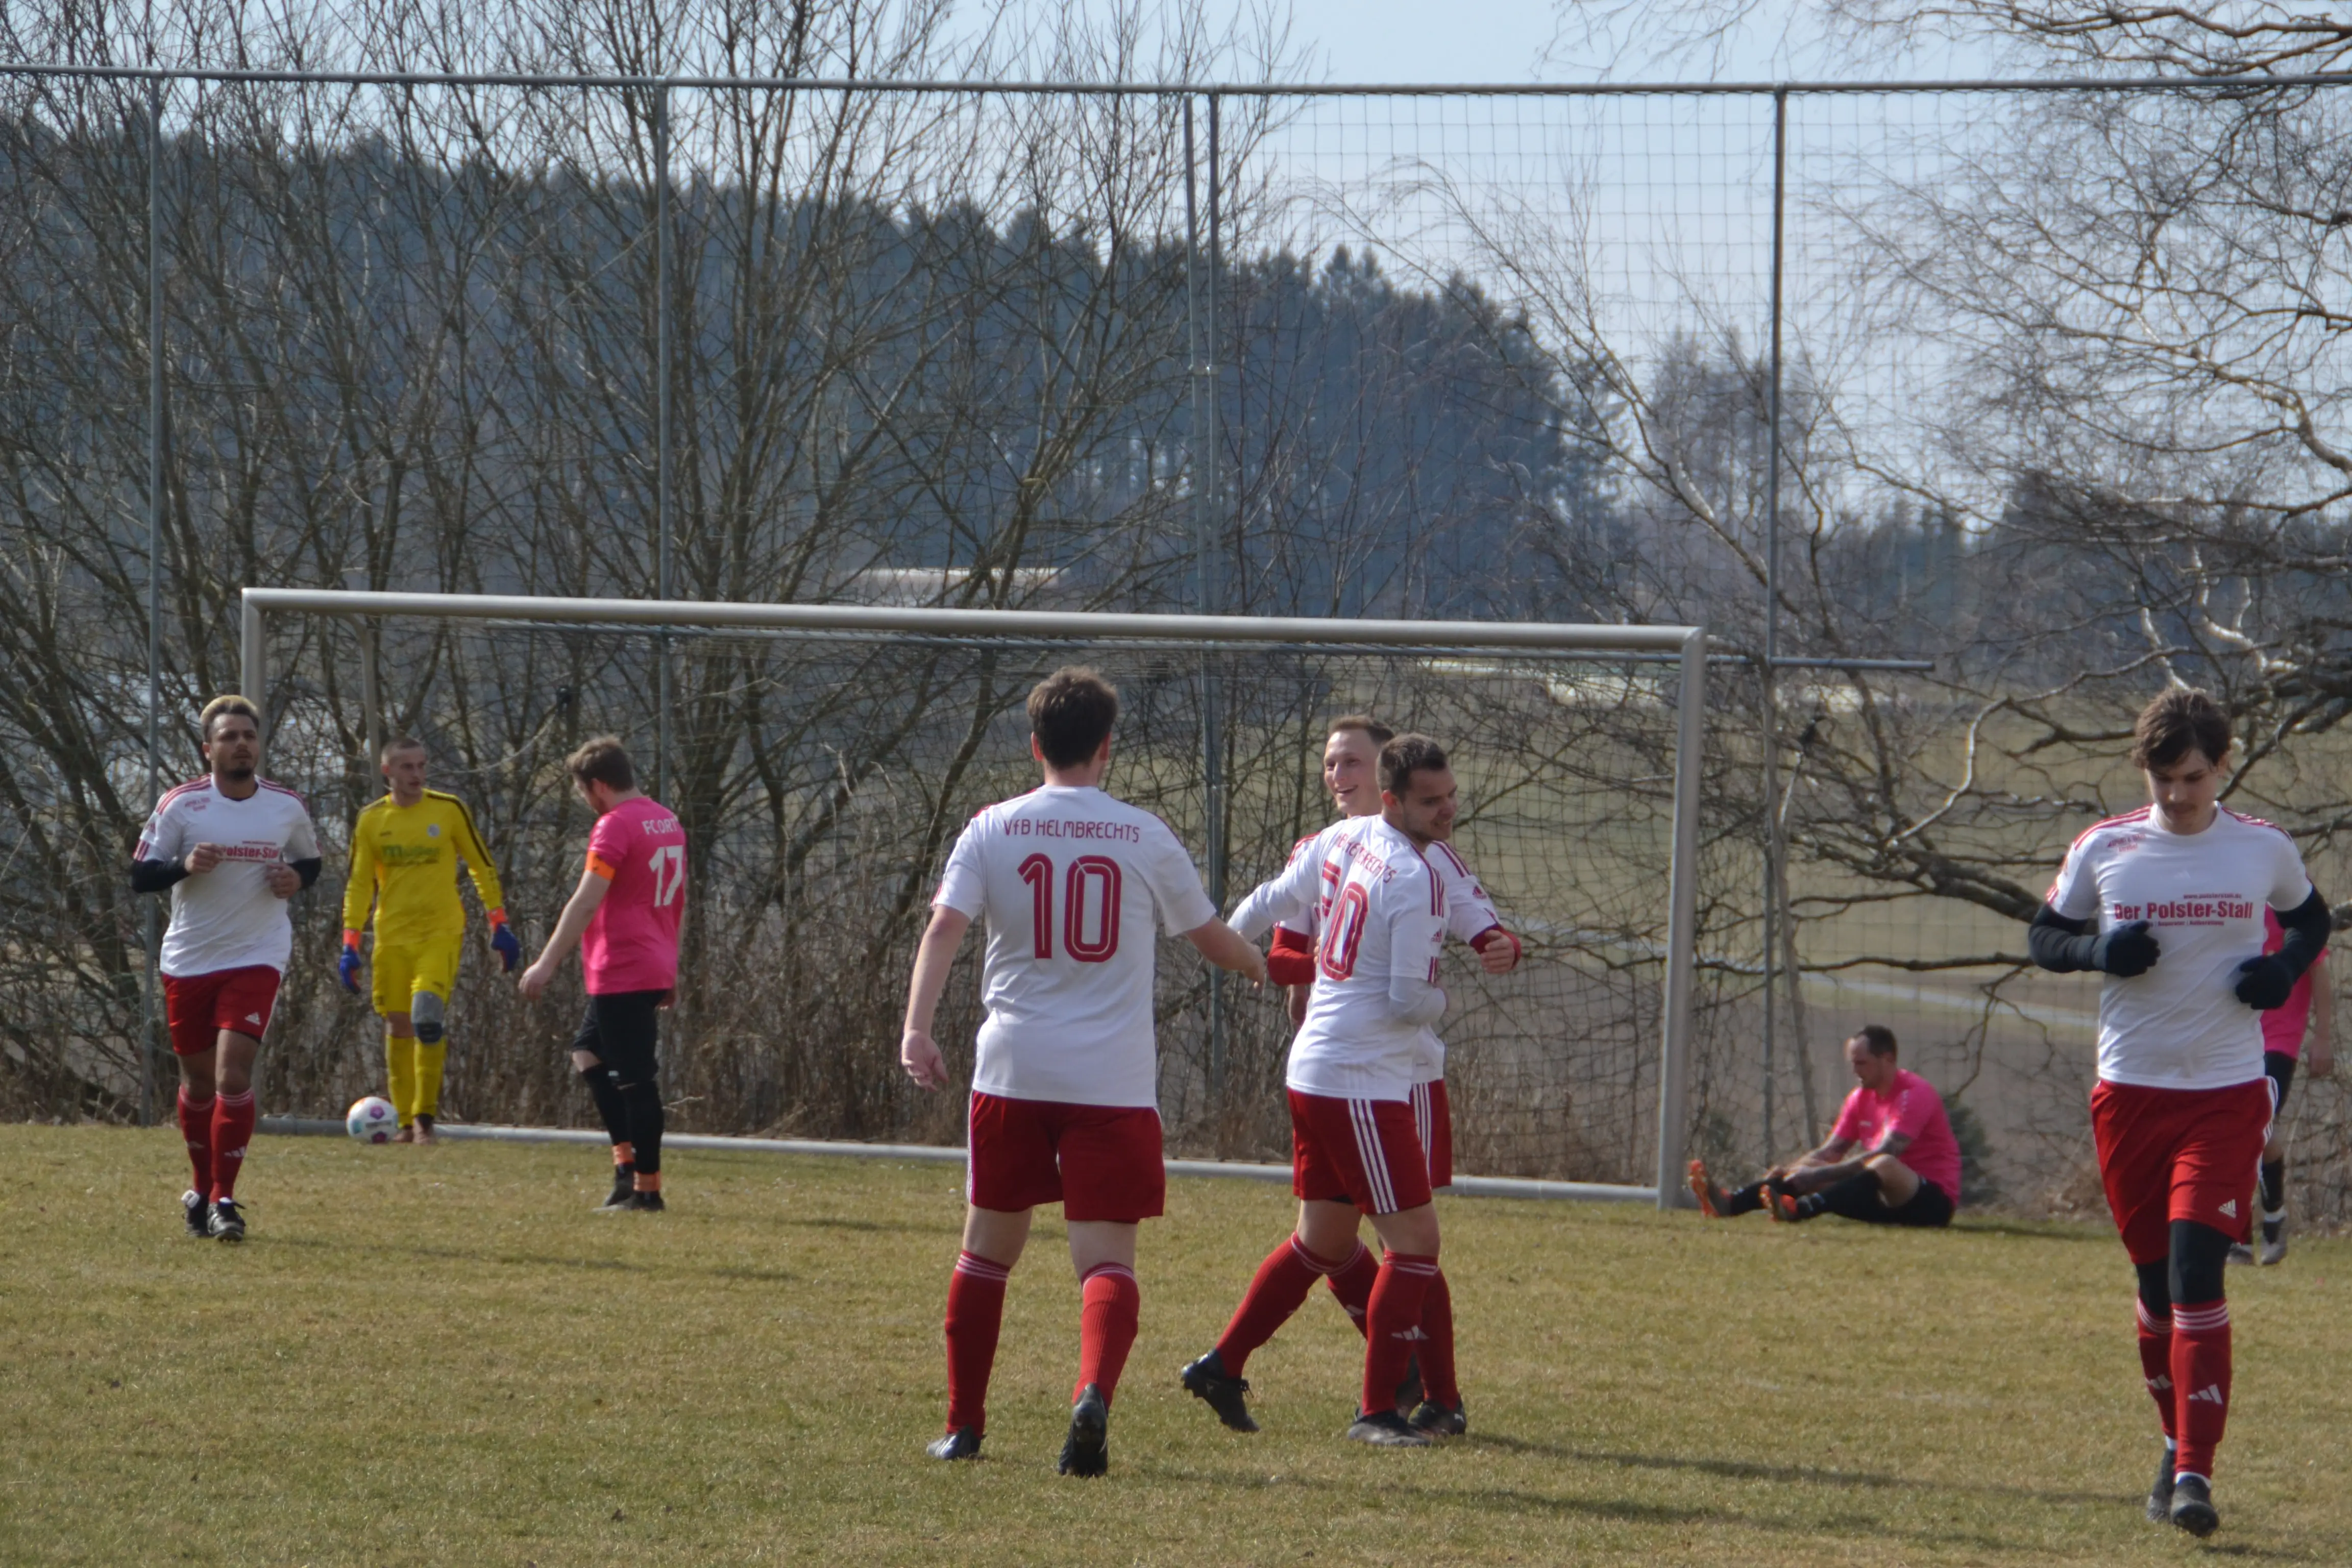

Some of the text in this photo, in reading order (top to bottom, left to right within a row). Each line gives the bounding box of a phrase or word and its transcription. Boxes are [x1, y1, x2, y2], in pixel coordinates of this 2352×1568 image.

[642, 819, 658, 835] FC
[1004, 819, 1140, 843] VfB HELMBRECHTS
[648, 845, 683, 908] 17
[1017, 852, 1122, 963] 10
[2114, 901, 2253, 920] Der Polster-Stall
